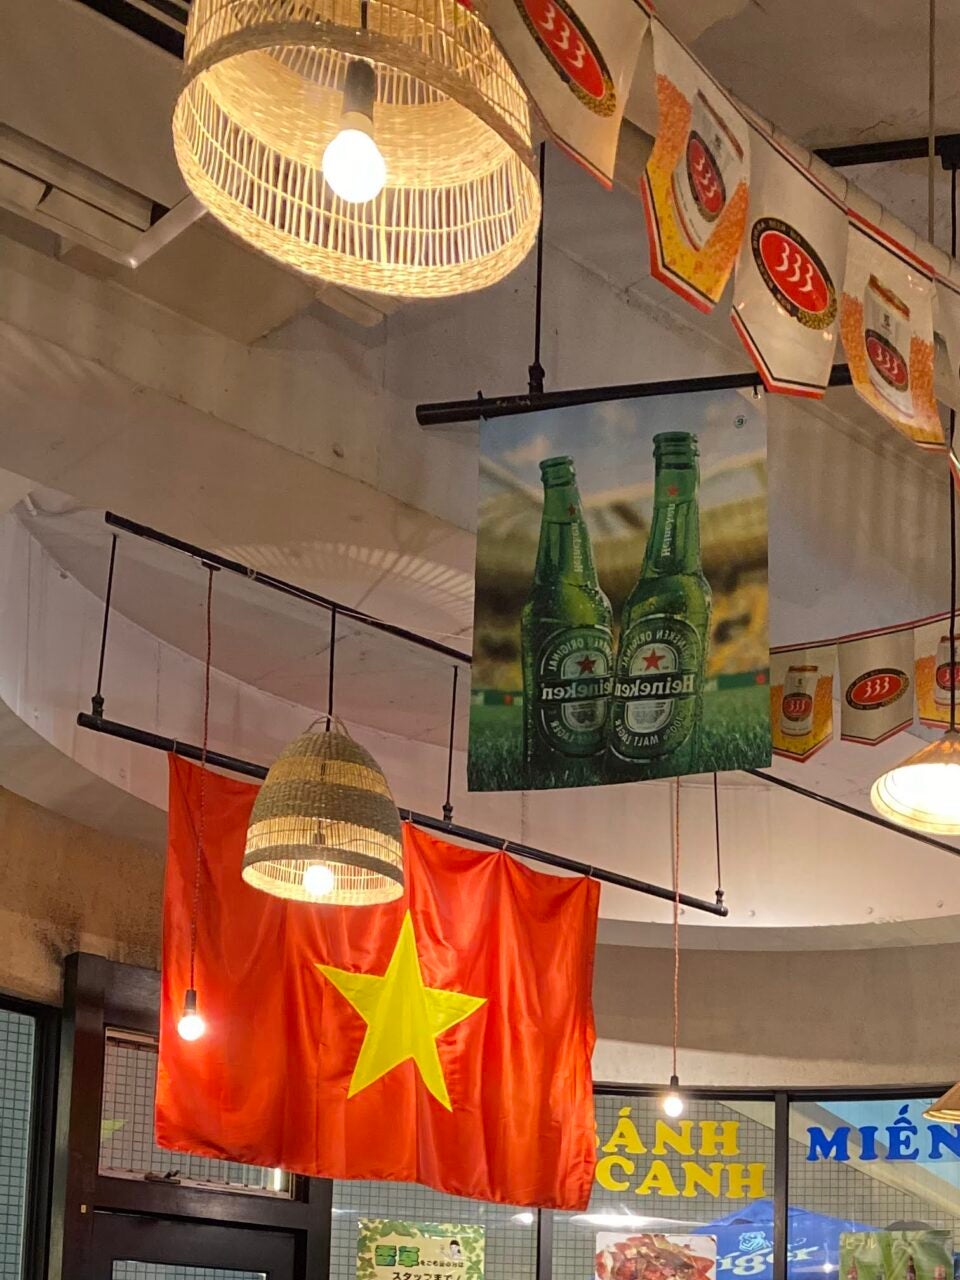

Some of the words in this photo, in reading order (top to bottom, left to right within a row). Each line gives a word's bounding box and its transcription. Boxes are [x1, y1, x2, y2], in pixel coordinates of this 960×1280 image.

[538, 2, 586, 69] 333
[694, 151, 718, 199] 333
[775, 241, 814, 292] 333
[876, 347, 900, 376] 333
[788, 701, 806, 714] 333
[863, 676, 891, 699] 333
[595, 1106, 741, 1157] ÁNH
[595, 1154, 767, 1199] CANH
